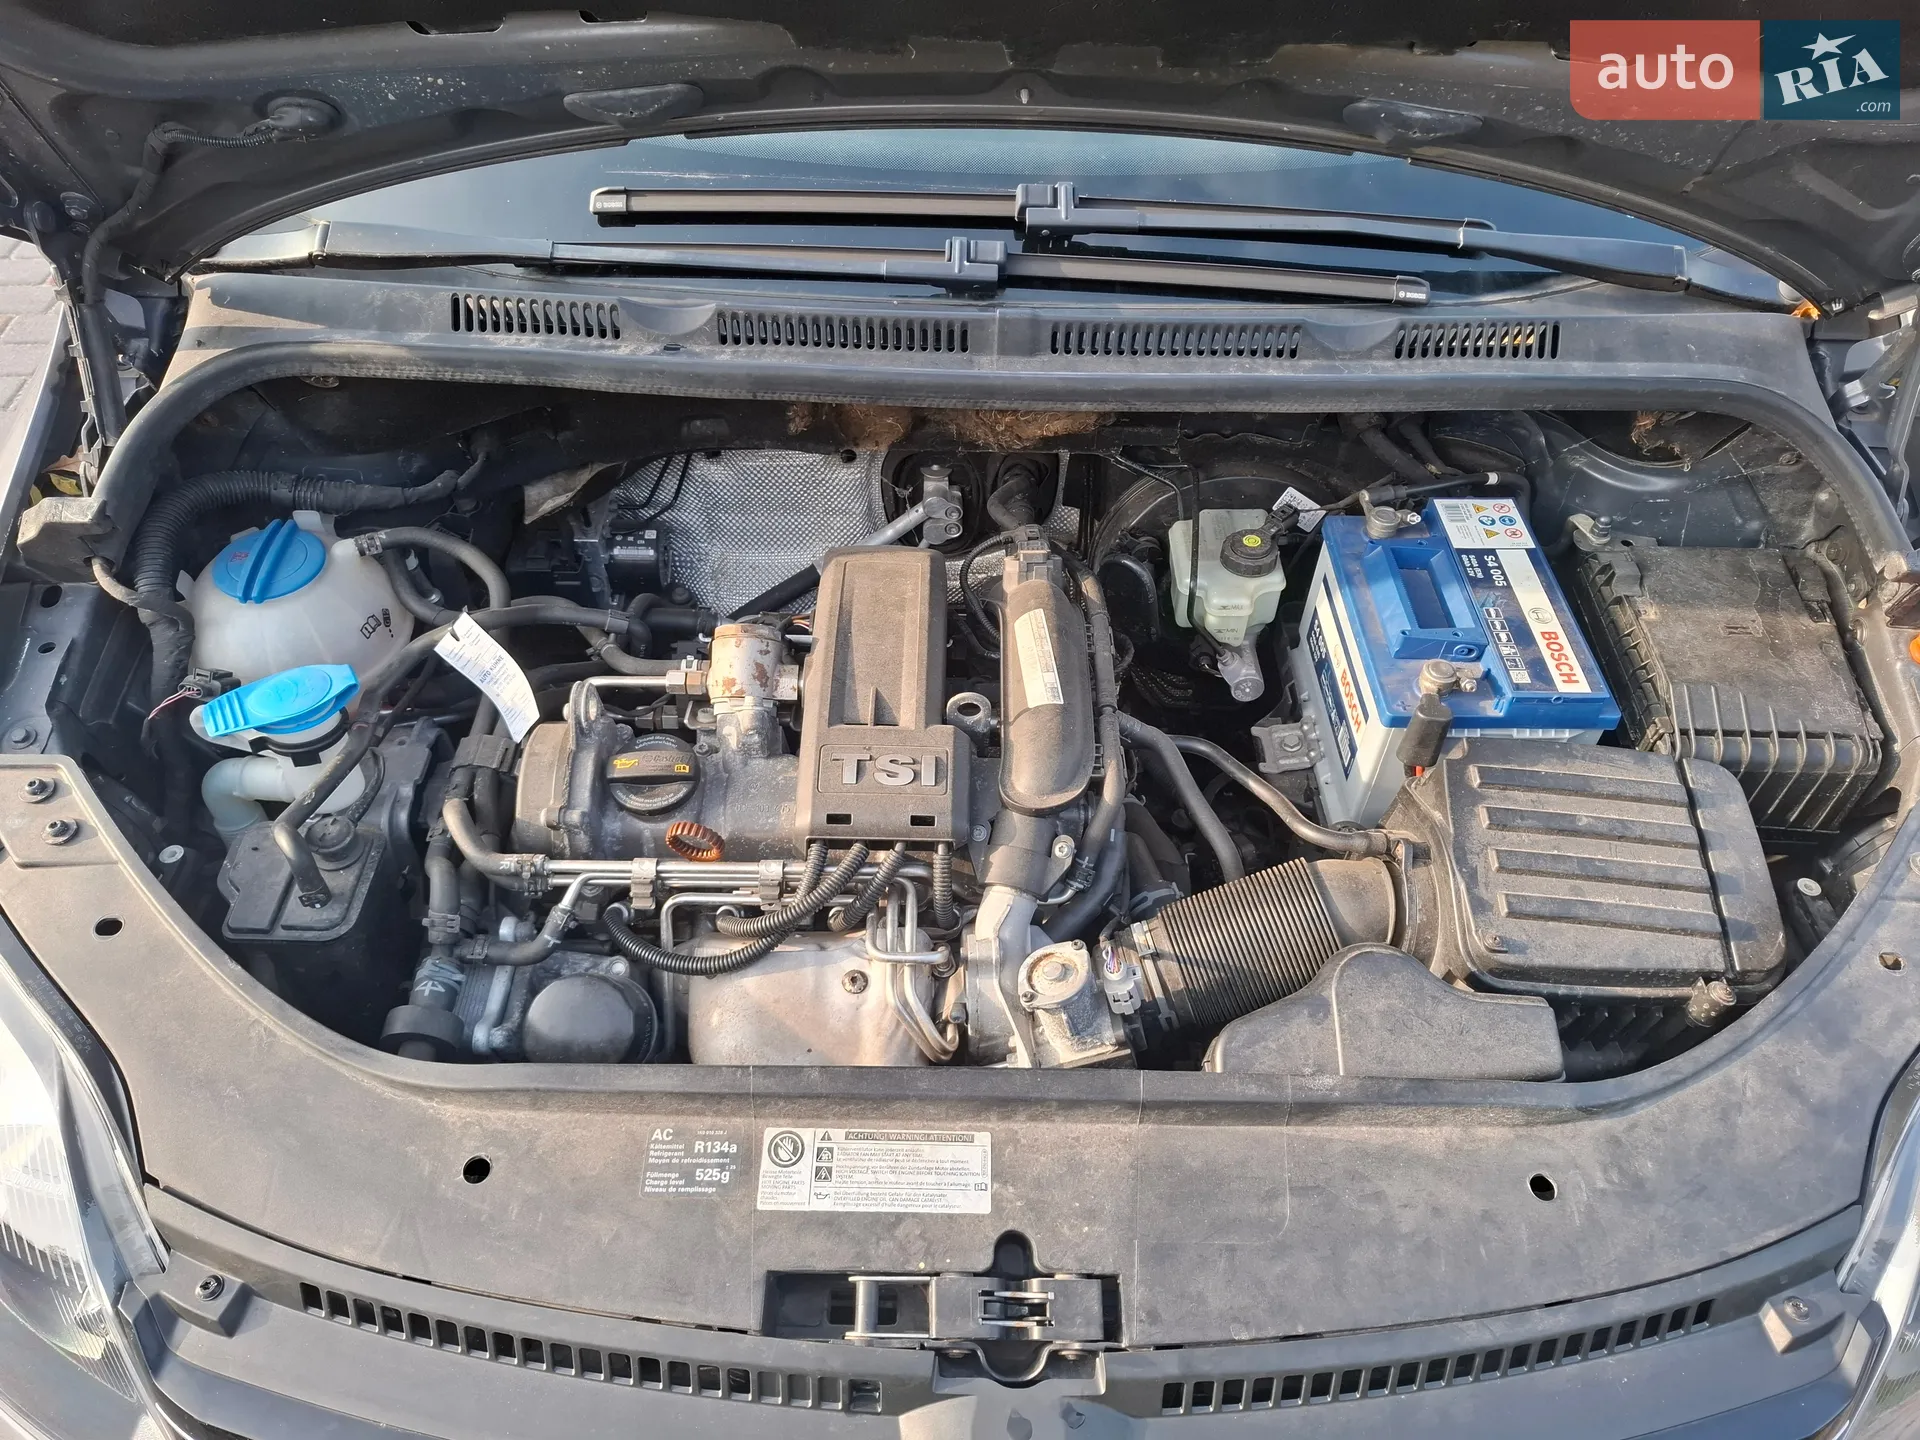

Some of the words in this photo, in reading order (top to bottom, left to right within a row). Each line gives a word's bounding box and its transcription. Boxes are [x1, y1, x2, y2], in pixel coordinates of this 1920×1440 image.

[1490, 570, 1508, 587] 005
[1540, 631, 1580, 684] BOSCH
[480, 670, 492, 684] AUTO
[1341, 668, 1362, 733] BOSCH
[830, 752, 936, 786] TSI
[652, 1128, 674, 1140] AC
[694, 1141, 738, 1154] R134a
[695, 1168, 730, 1184] 525g
